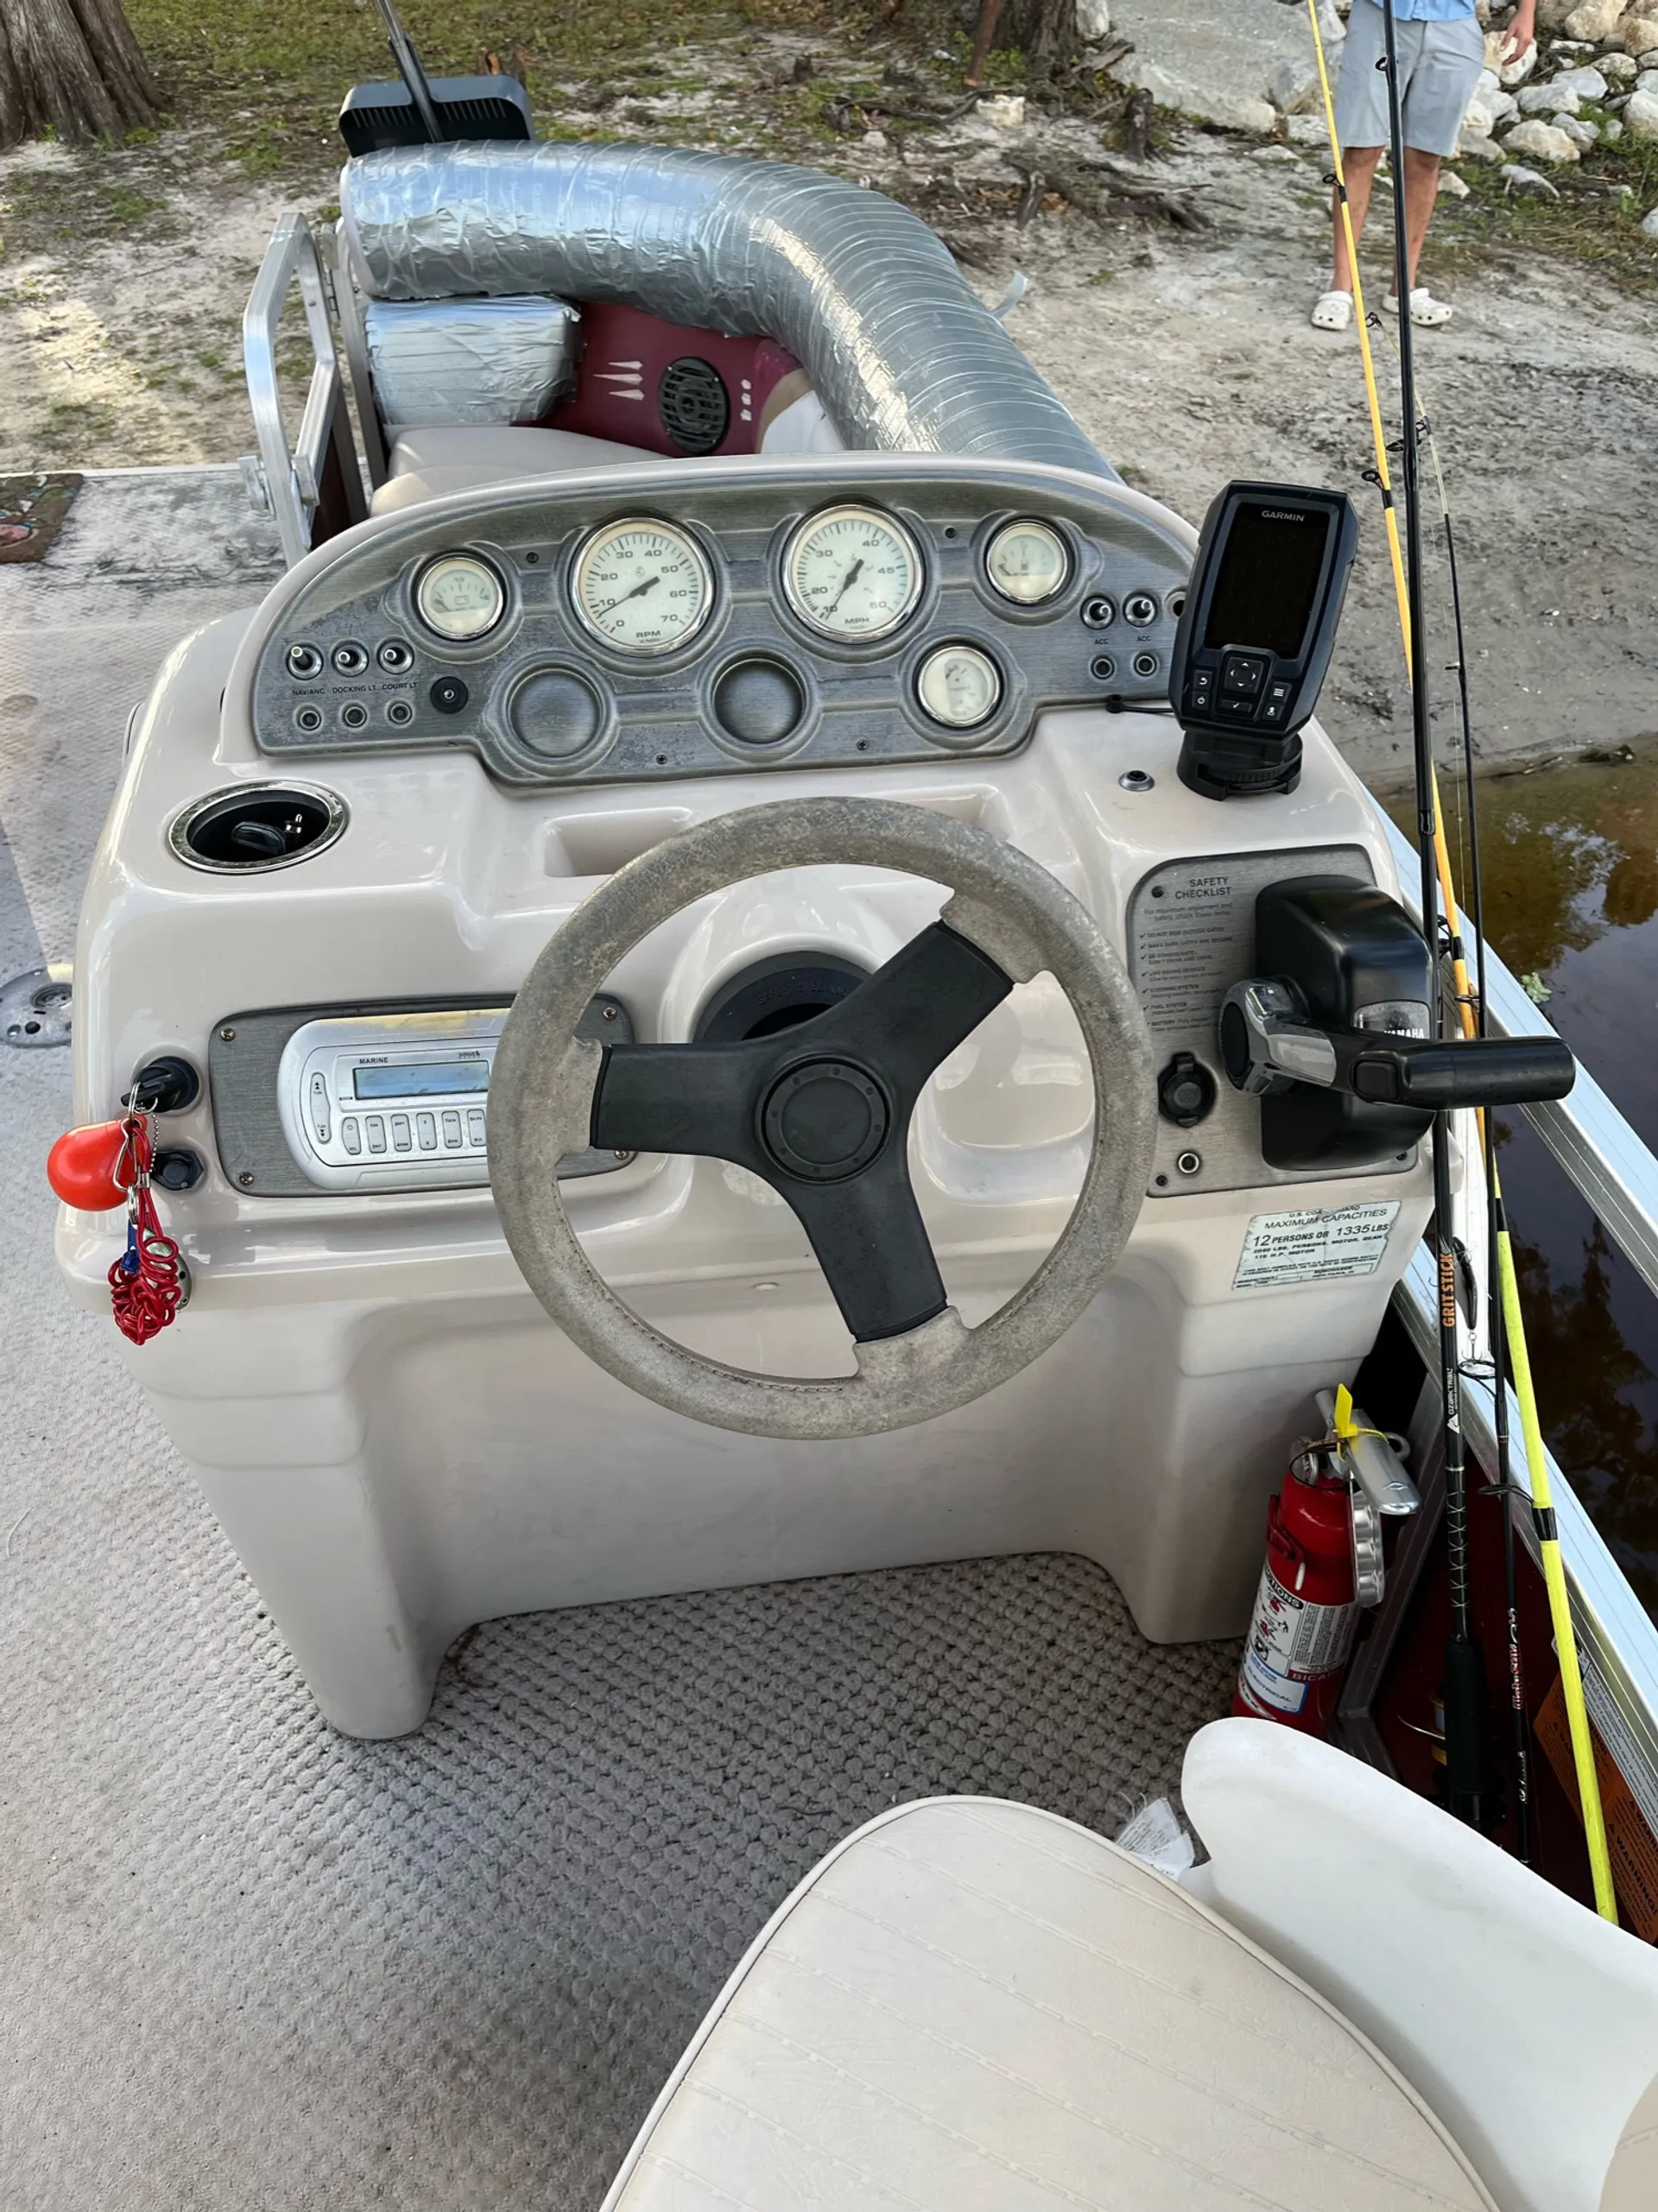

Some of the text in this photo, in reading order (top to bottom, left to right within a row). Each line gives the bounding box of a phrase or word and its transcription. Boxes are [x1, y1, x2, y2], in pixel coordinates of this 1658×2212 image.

[1261, 509, 1306, 521] GARMIN
[615, 550, 634, 559] 30
[644, 549, 662, 558] 40
[815, 549, 833, 558] 30
[661, 565, 679, 574] 50
[600, 572, 618, 581] 20
[669, 590, 687, 598] 60
[811, 586, 828, 595] 20
[661, 614, 679, 623] 70
[616, 619, 625, 628] 0
[636, 630, 661, 639] RPM
[292, 687, 326, 696] NAV/ANC
[332, 686, 366, 694] DOCKING
[1189, 876, 1230, 888] SAFETY
[1174, 887, 1232, 900] CHECKLIST
[1264, 1208, 1388, 1229] MAXIMUM CAPACITIES
[1253, 1234, 1271, 1248] 12
[1271, 1232, 1314, 1244] PERSONS
[1316, 1230, 1330, 1239] OR
[1336, 1223, 1371, 1236] 1335
[1440, 1252, 1456, 1328] GRIT STICK
